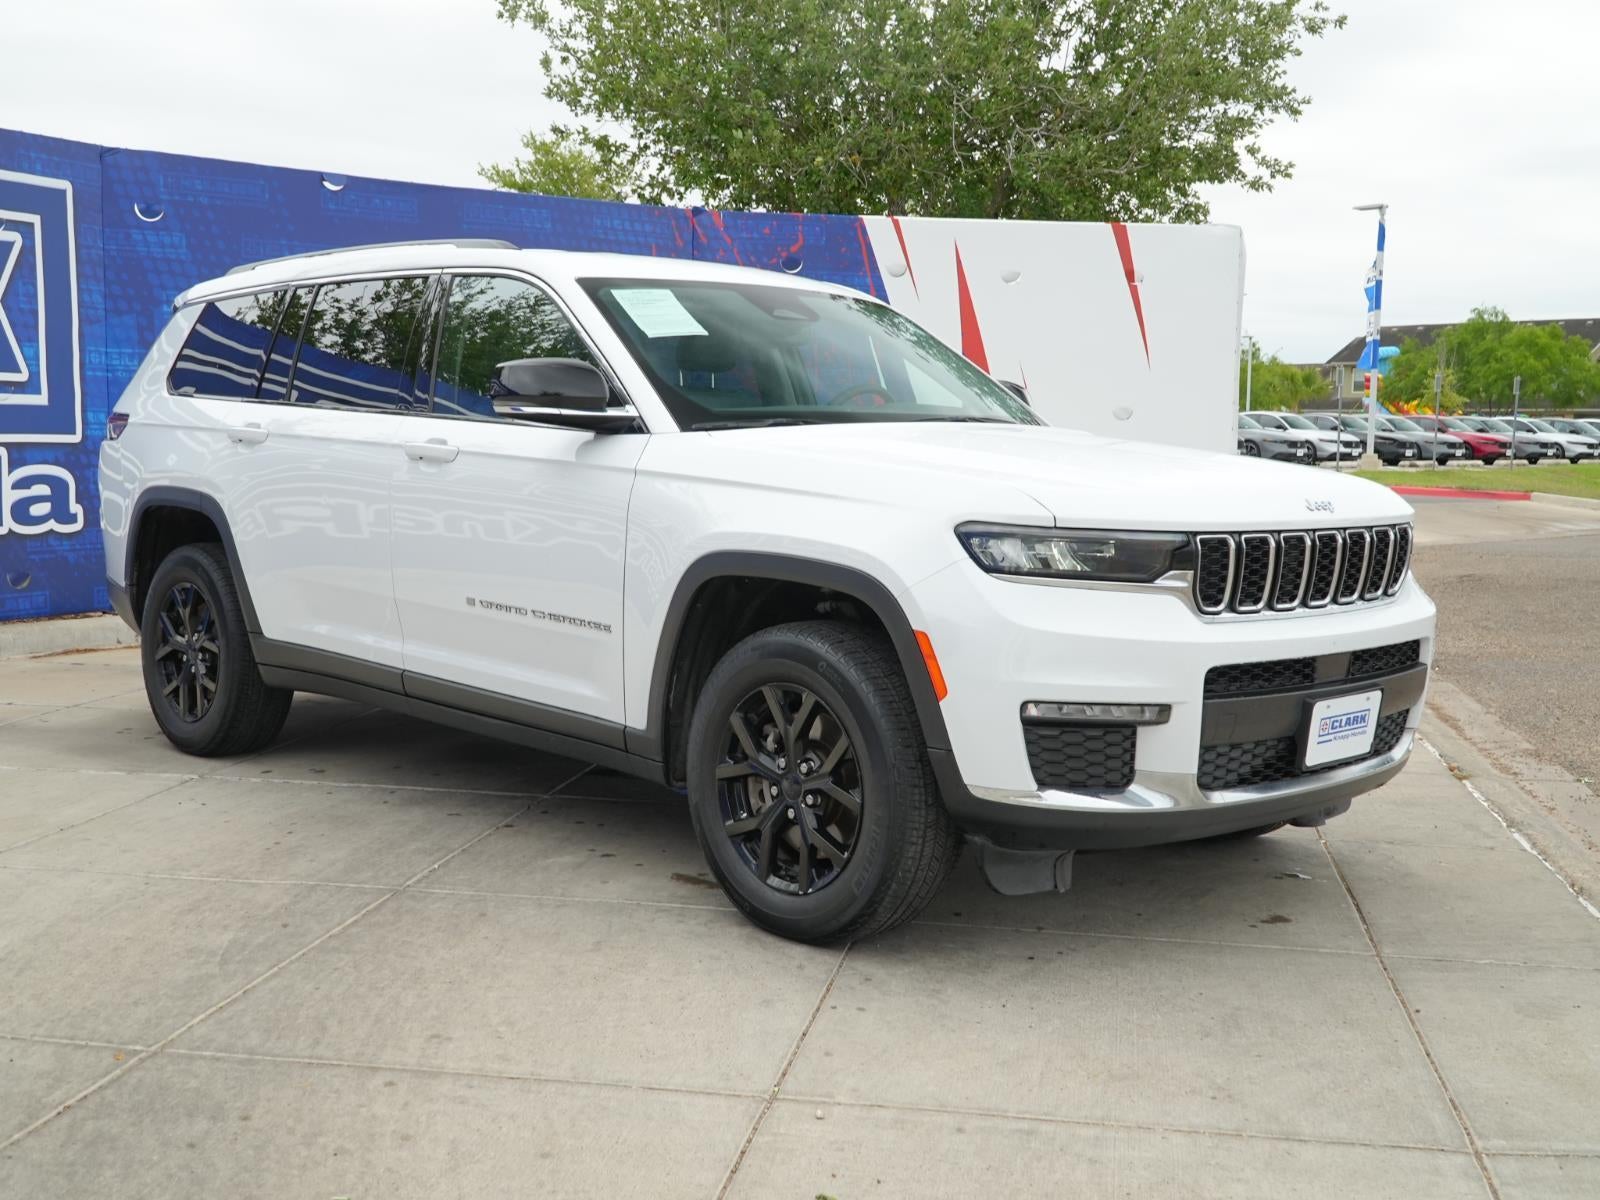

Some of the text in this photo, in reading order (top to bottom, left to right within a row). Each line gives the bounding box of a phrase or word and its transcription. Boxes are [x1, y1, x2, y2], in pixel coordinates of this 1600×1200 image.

[1304, 498, 1334, 514] Jeep
[479, 599, 528, 615] GRAND
[1330, 713, 1367, 730] CLARK
